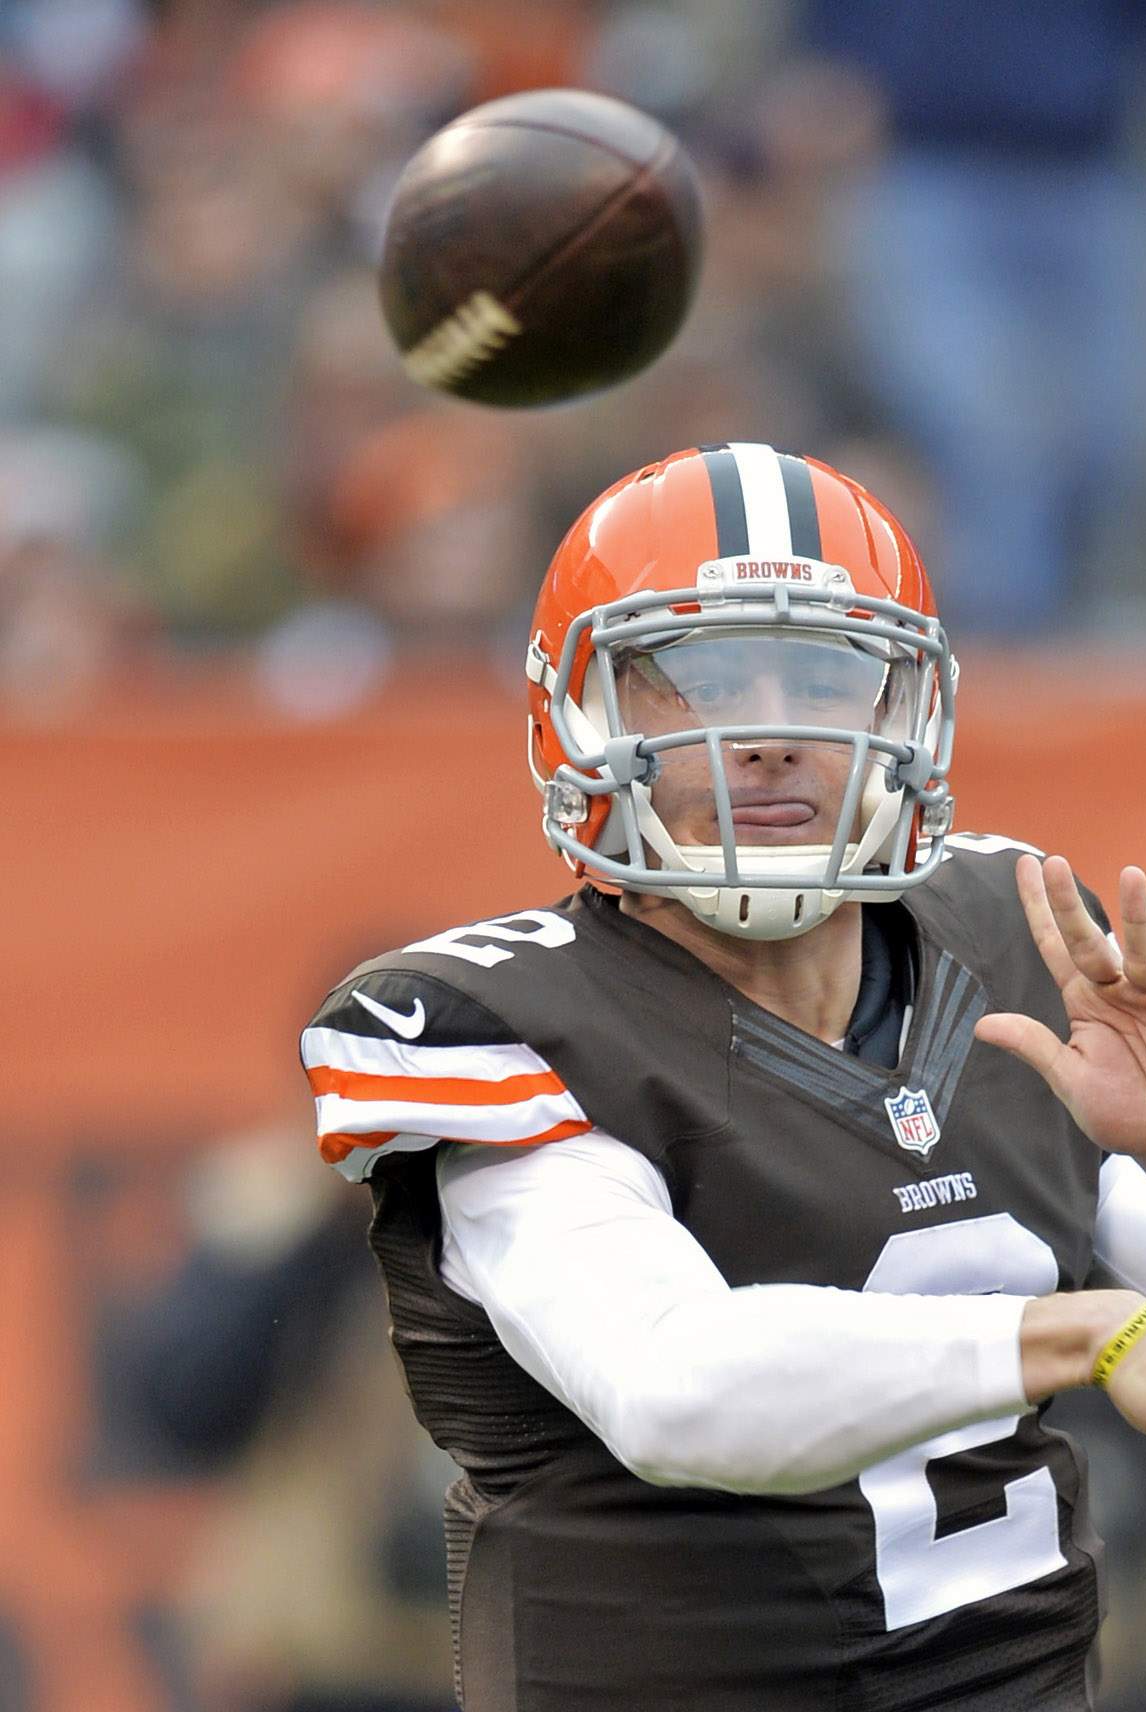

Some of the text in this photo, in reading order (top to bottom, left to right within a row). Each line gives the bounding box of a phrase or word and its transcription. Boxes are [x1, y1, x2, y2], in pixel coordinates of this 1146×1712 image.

[736, 561, 813, 582] BROWNS
[401, 909, 577, 969] 2
[901, 1115, 933, 1141] NFL
[893, 1172, 978, 1214] BROWNS
